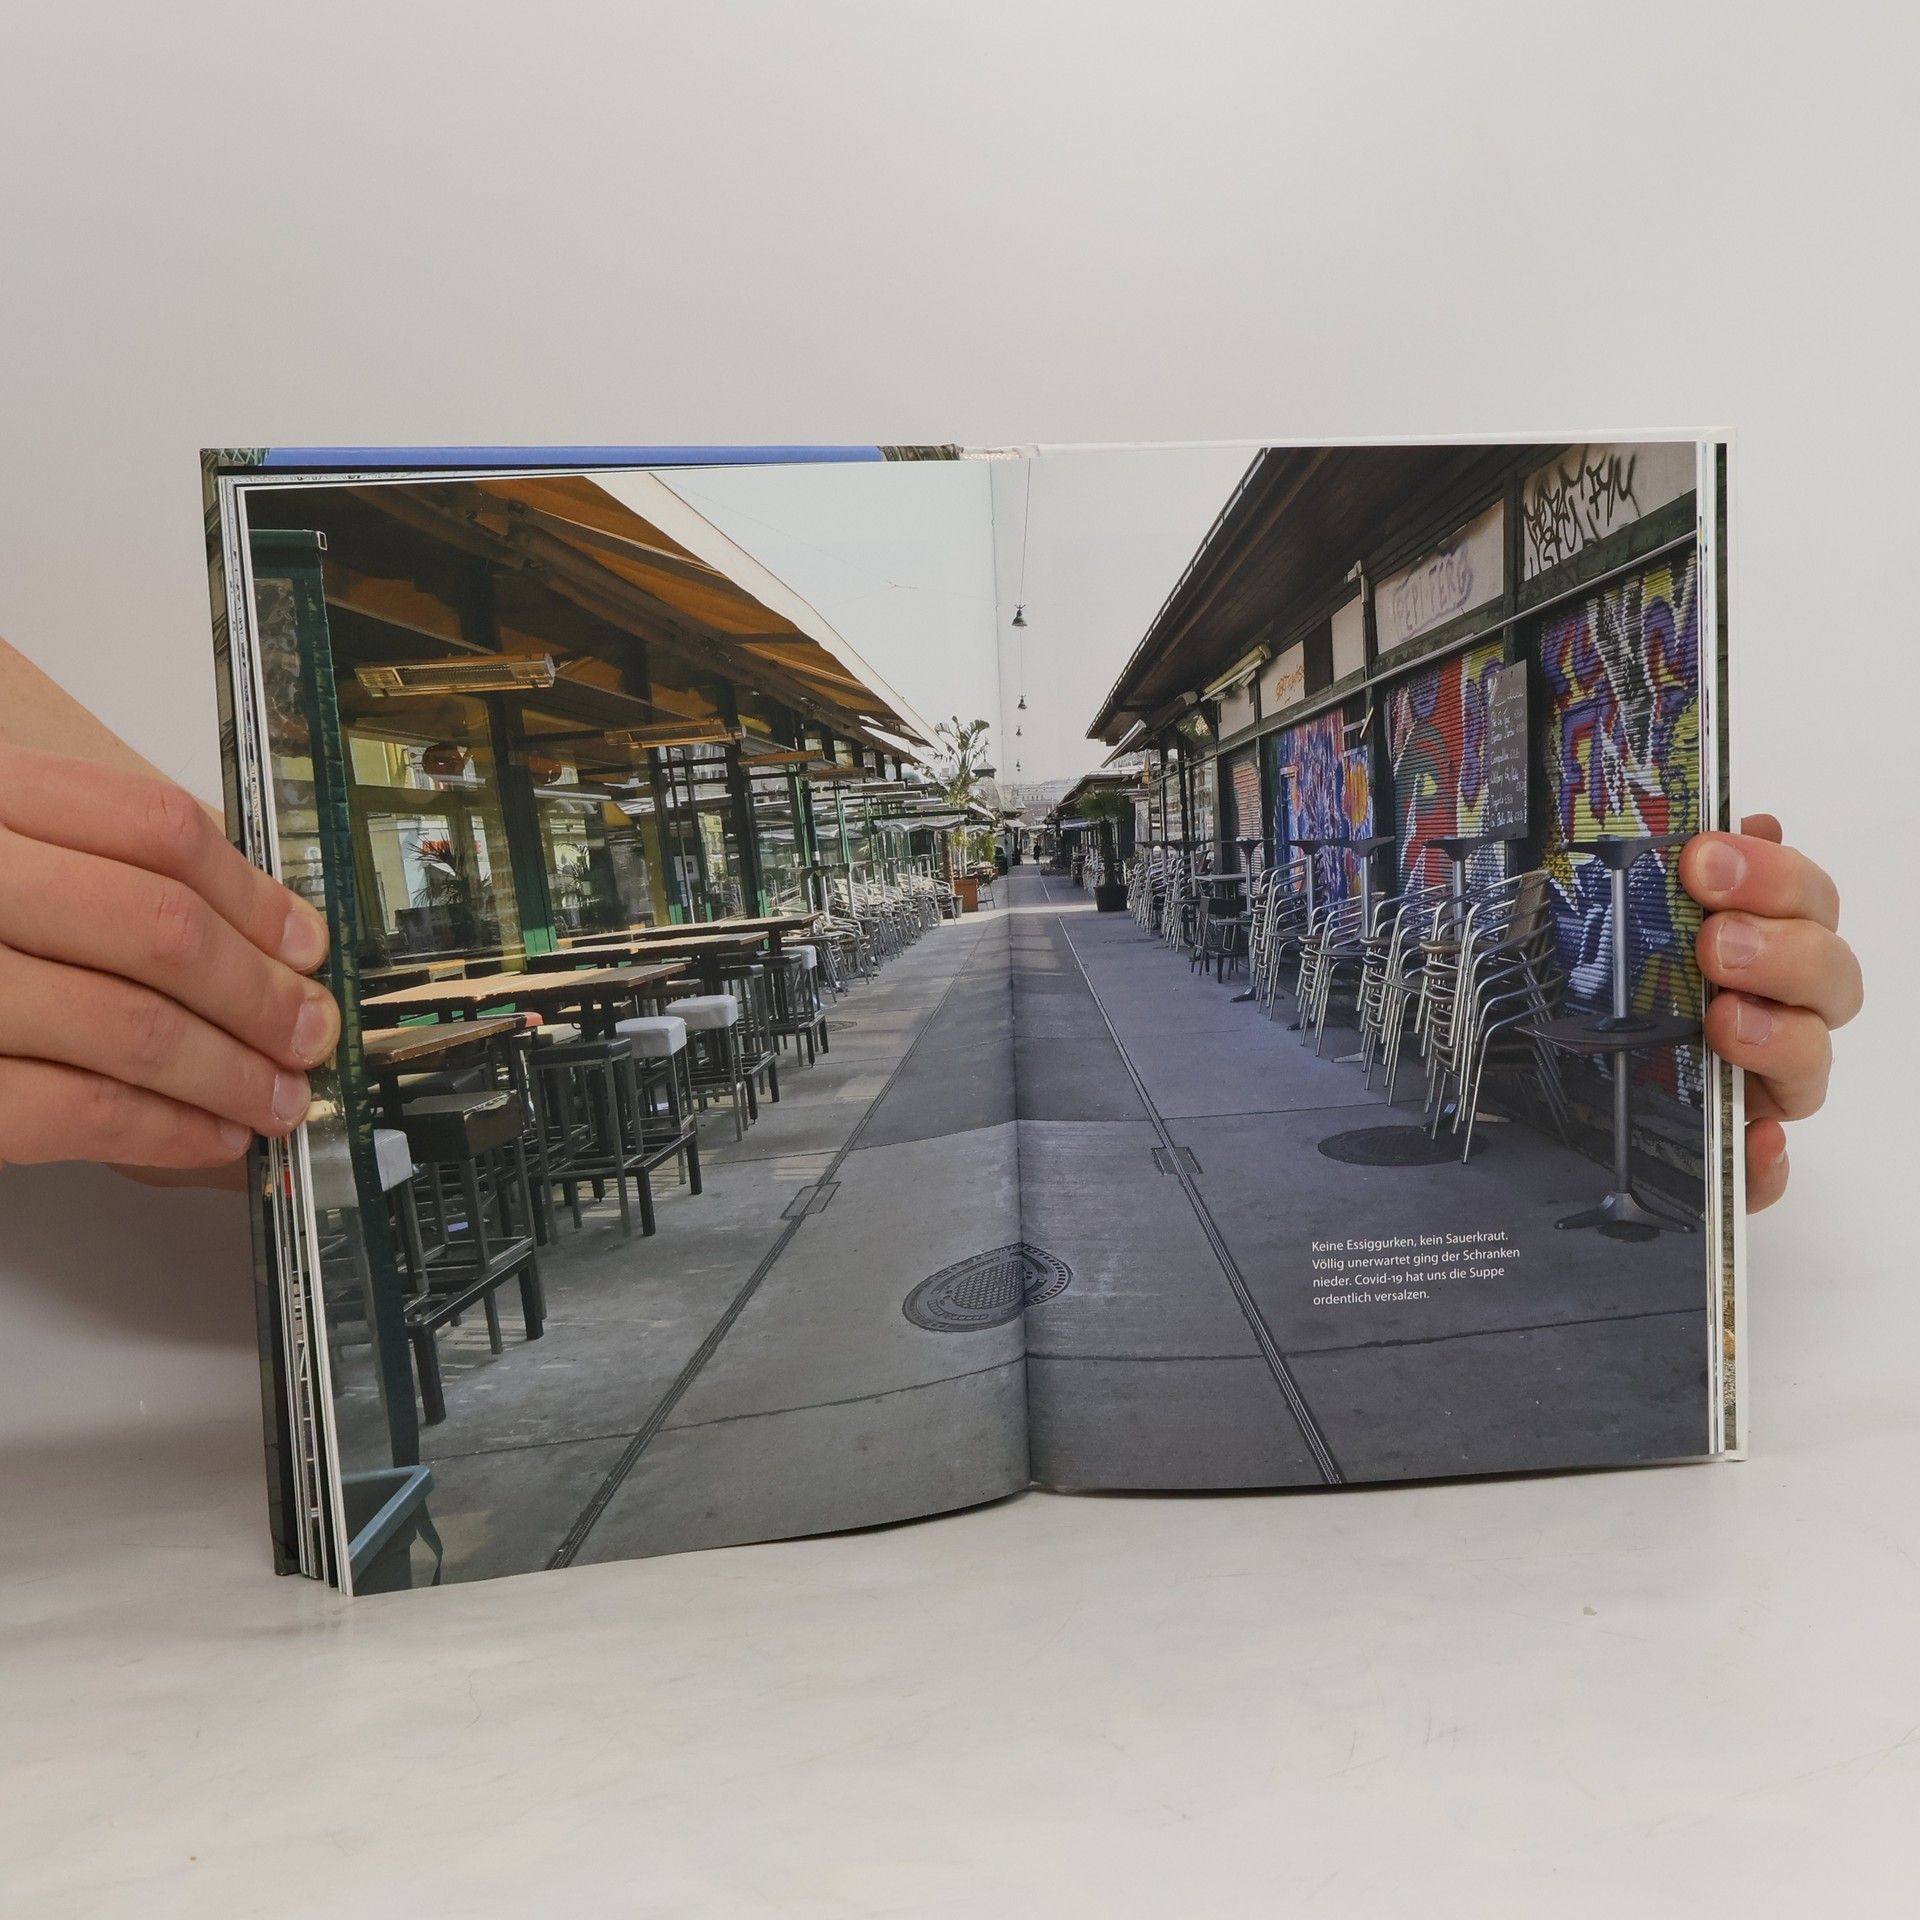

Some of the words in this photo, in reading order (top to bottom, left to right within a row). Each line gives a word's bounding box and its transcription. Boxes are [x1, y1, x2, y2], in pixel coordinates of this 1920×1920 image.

[1311, 1240, 1344, 1253] Keine
[1346, 1234, 1418, 1252] Essiggurken,
[1419, 1234, 1443, 1246] kein
[1445, 1230, 1509, 1245] Sauerkraut.
[1311, 1257, 1345, 1272] Völlig
[1347, 1254, 1411, 1269] unerwartet
[1412, 1252, 1439, 1267] ging
[1441, 1250, 1461, 1263] der
[1462, 1247, 1521, 1262] Schranken
[1312, 1275, 1353, 1289] nieder.
[1354, 1271, 1404, 1287] Covid-19
[1405, 1271, 1425, 1283] hat
[1426, 1271, 1448, 1282] uns
[1449, 1267, 1468, 1280] die
[1469, 1266, 1506, 1281] Suppe
[1312, 1291, 1373, 1306] ordentlich
[1374, 1288, 1430, 1303] versalzen.
